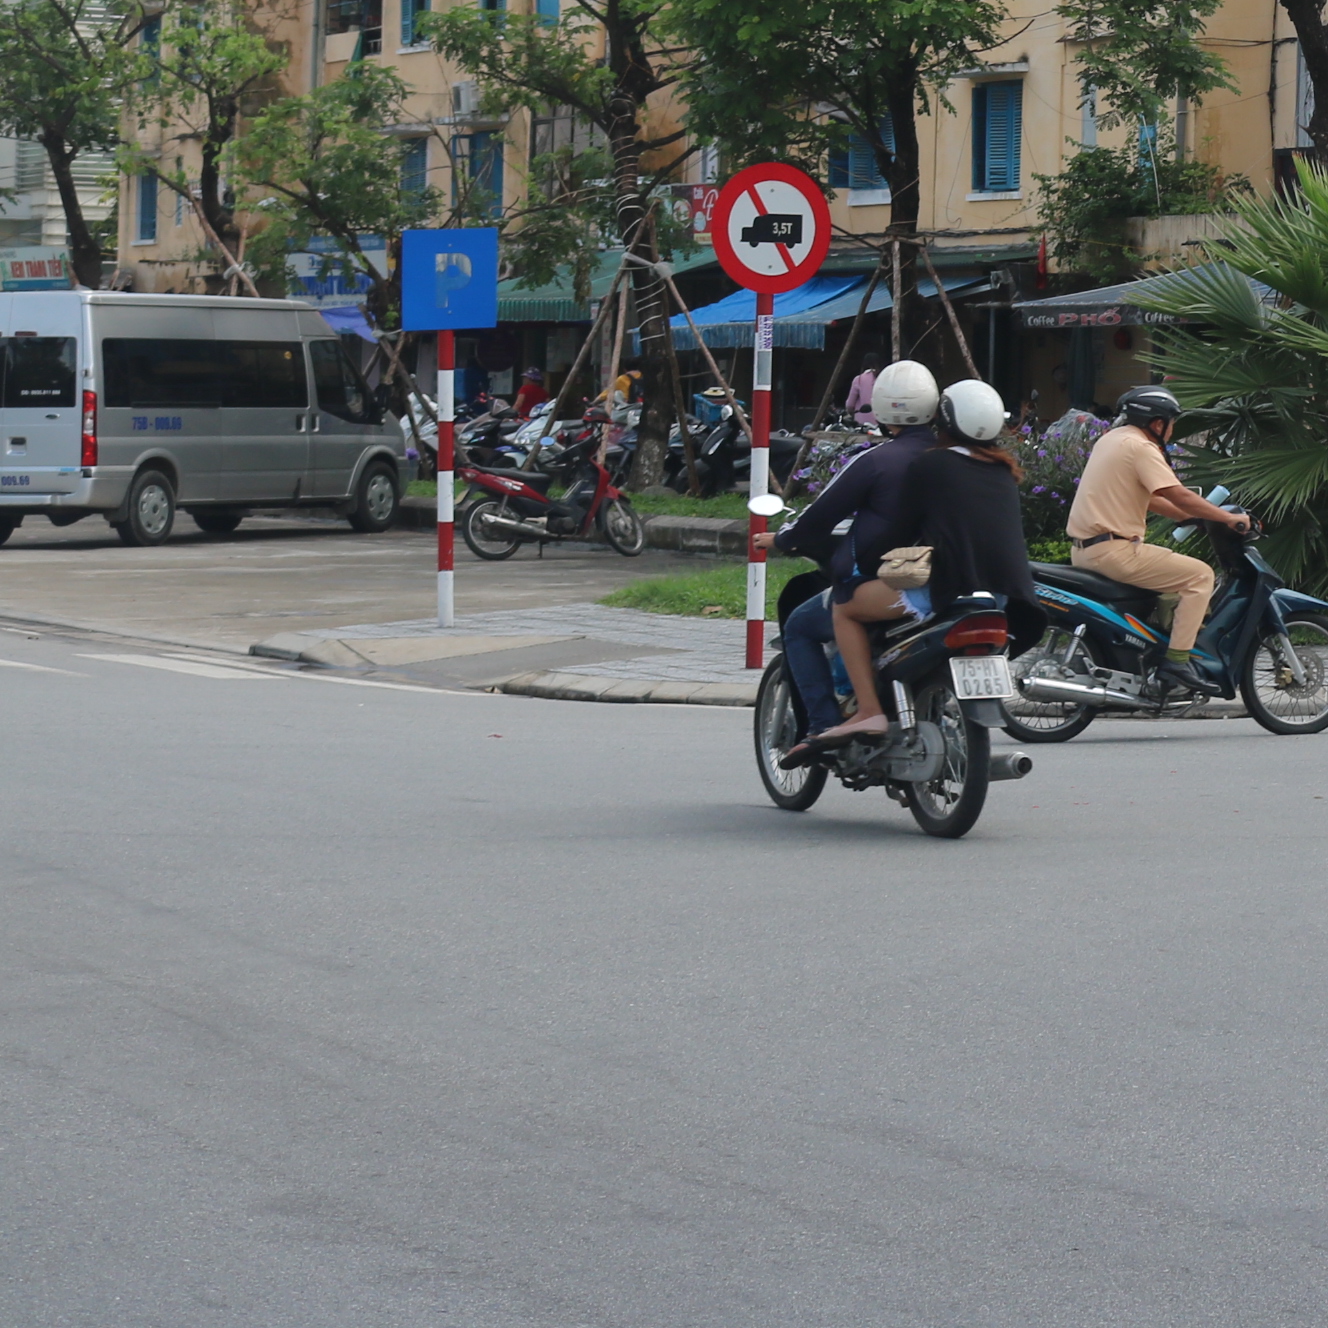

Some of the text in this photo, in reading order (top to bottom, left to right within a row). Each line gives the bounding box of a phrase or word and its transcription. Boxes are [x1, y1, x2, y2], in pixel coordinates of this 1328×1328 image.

[772, 222, 793, 237] 3,5T
[435, 253, 472, 308] P
[1027, 315, 1055, 327] Coffee
[1125, 633, 1146, 650] YAMAHA
[958, 659, 998, 677] 75-H1
[963, 678, 1004, 696] 0285
